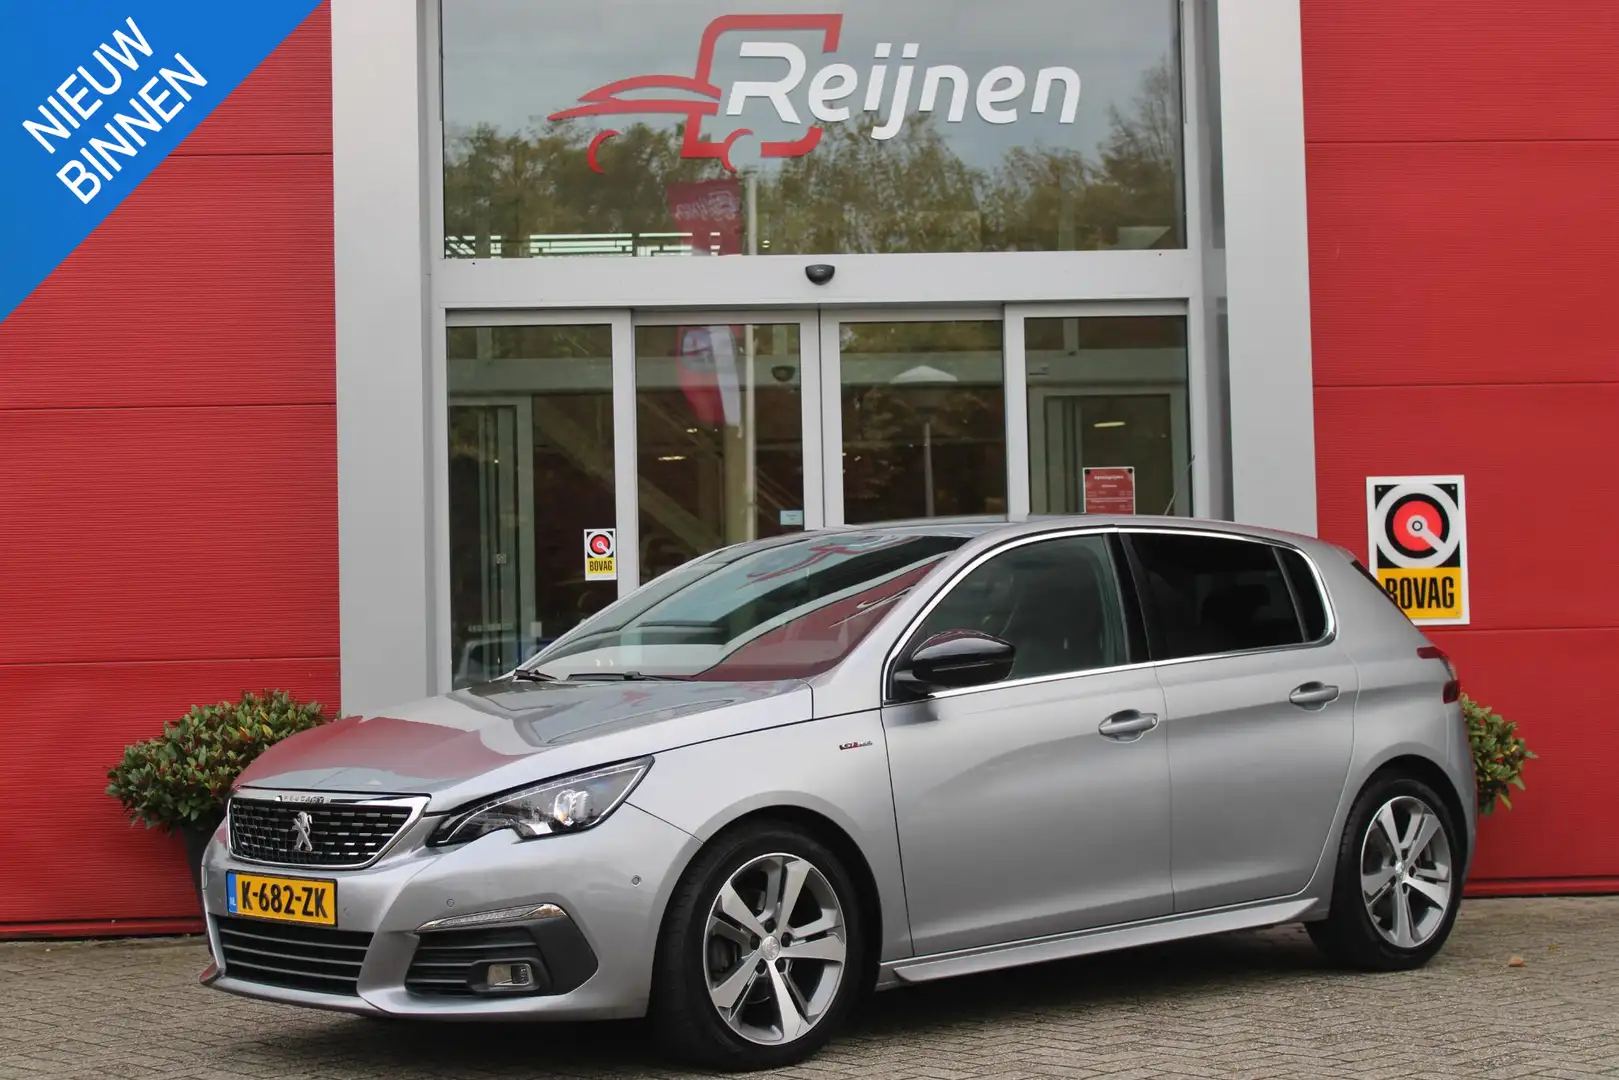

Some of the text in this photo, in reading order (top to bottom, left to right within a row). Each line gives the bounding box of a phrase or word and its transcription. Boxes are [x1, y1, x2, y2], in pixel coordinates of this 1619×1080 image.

[726, 41, 1081, 140] Reijnen
[589, 560, 613, 571] BOVAG
[1385, 576, 1455, 610] BOVAG
[241, 880, 328, 918] K-682-ZK
